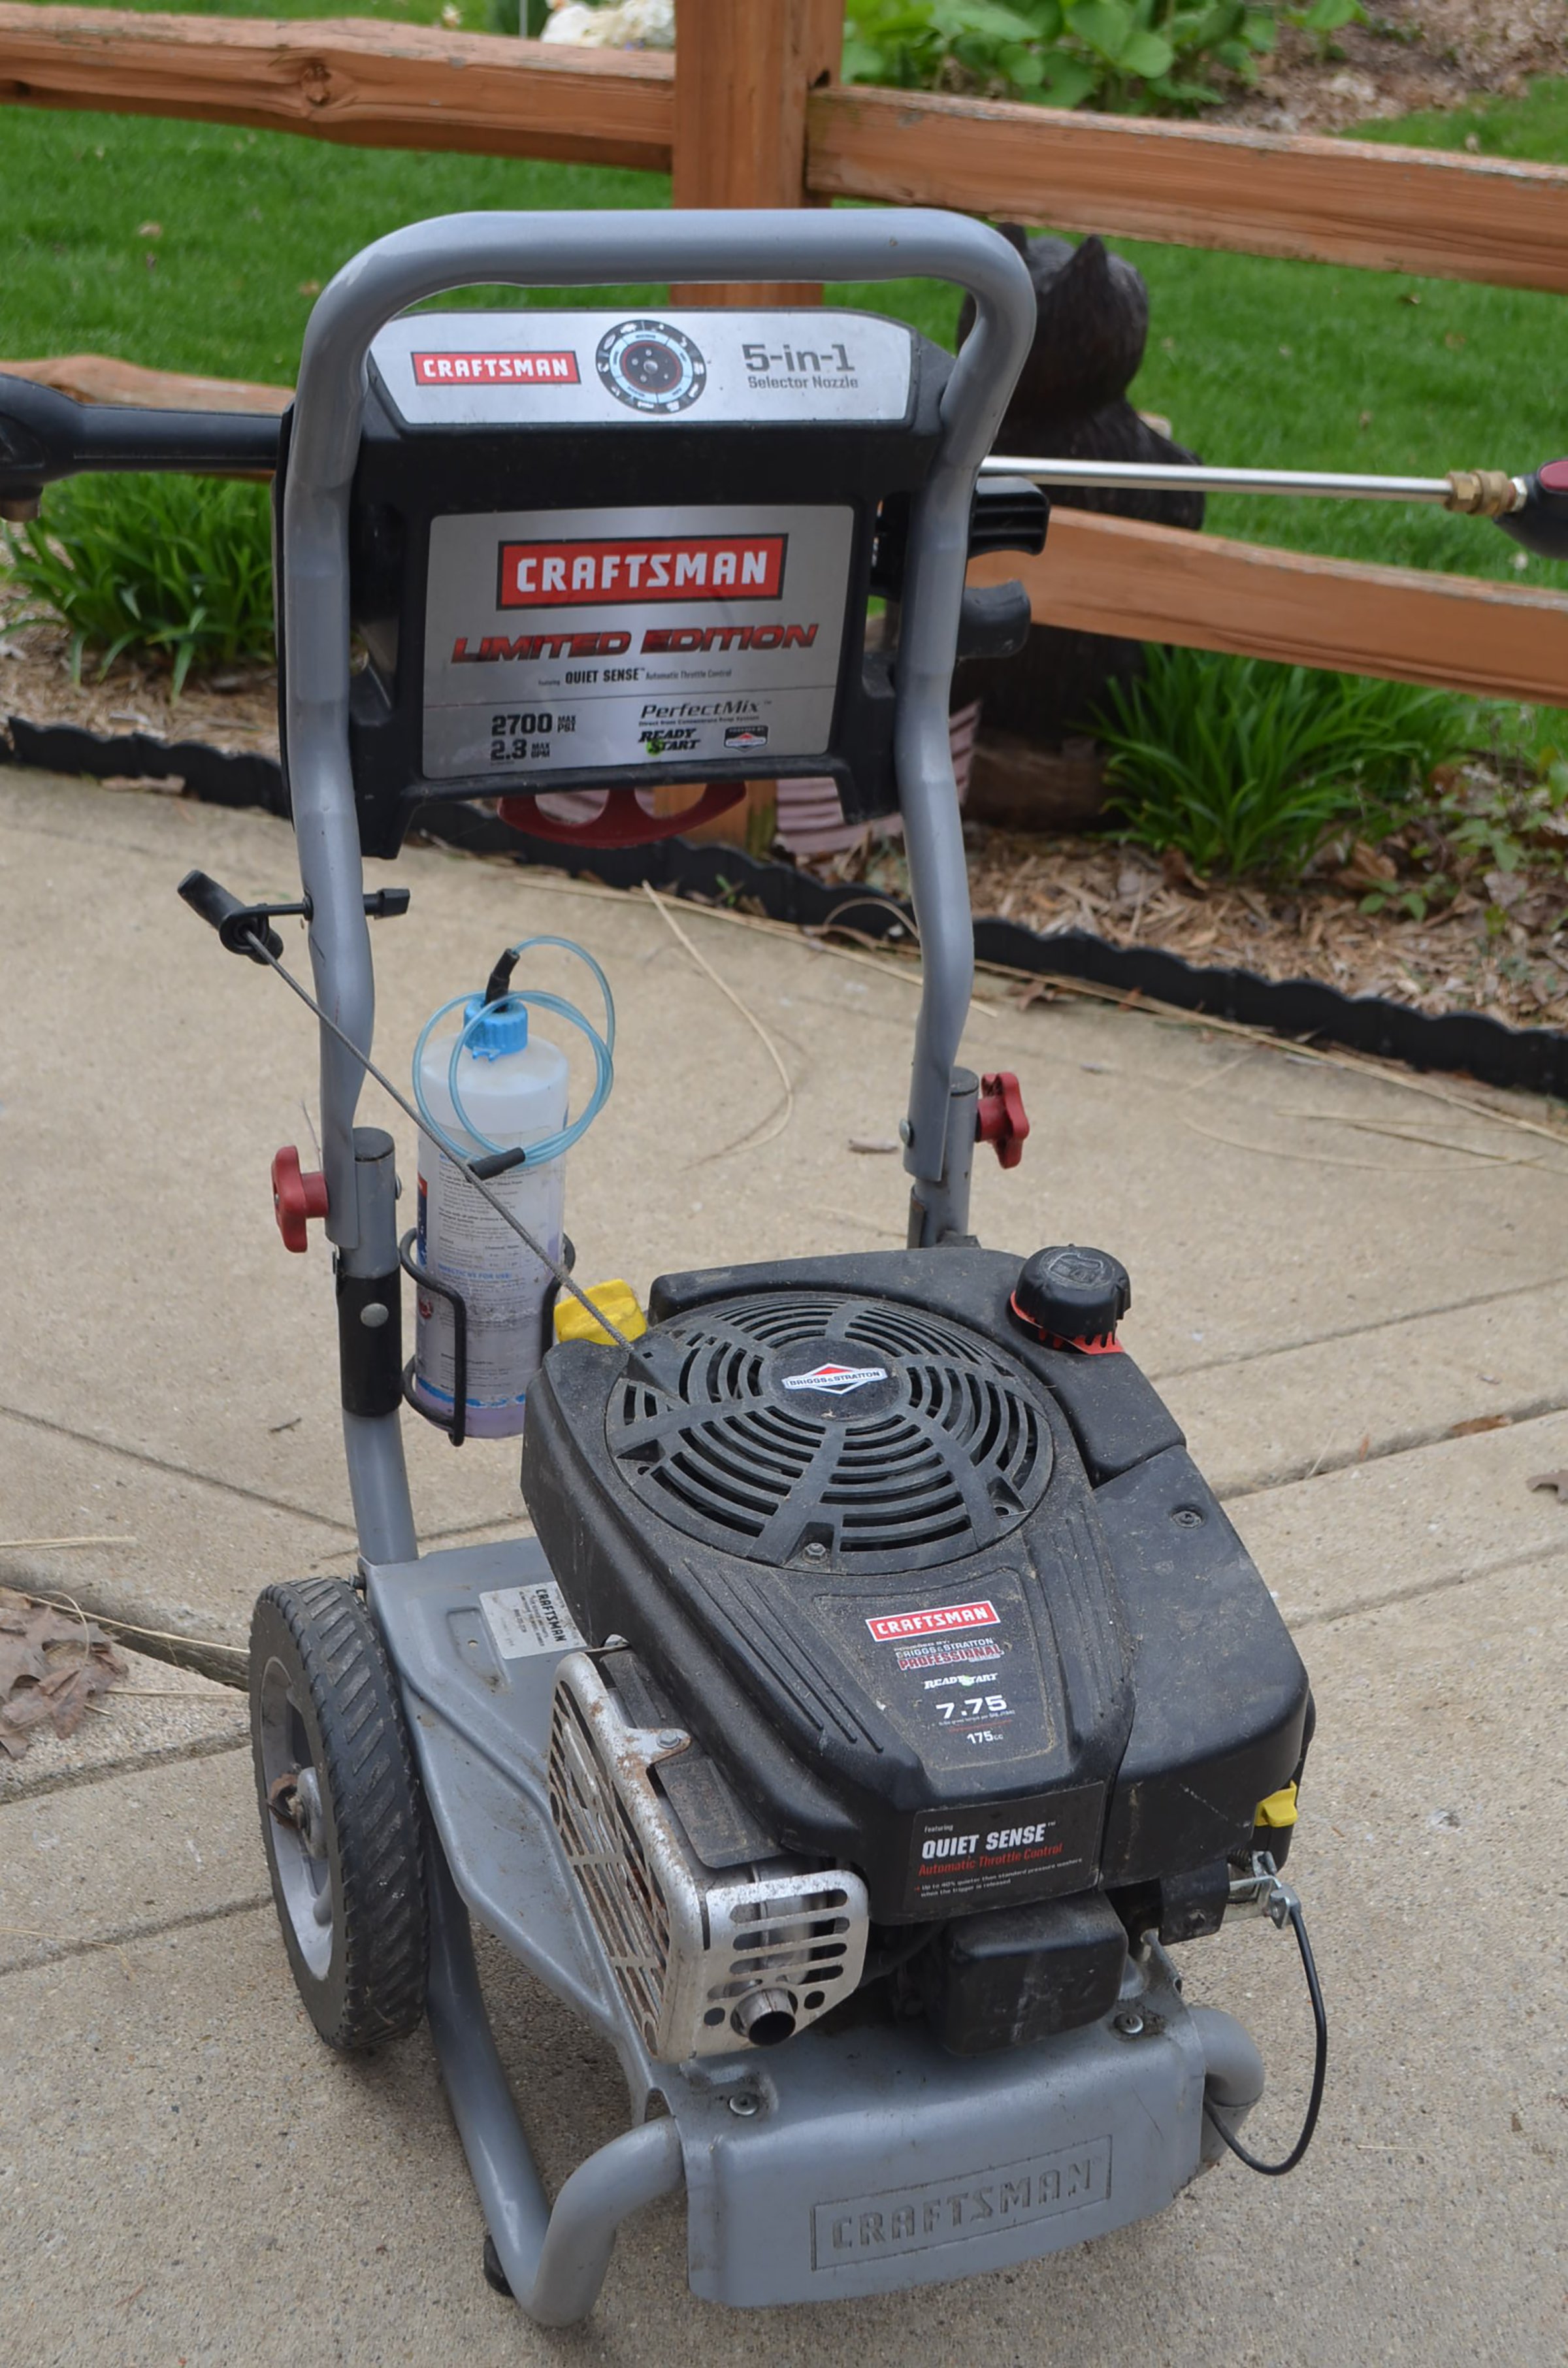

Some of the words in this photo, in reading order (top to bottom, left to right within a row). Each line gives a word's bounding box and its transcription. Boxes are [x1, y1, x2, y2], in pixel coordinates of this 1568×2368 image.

[423, 359, 568, 378] CRAFTSMAN
[742, 344, 855, 372] 5-in-1
[747, 376, 809, 389] Selector
[812, 374, 858, 388] Nozzle
[516, 551, 768, 593] CRAFTSMAN
[450, 631, 632, 664] LIMITED
[640, 623, 820, 655] EDITION
[565, 670, 599, 685] QUIET
[491, 713, 553, 736] 2700
[557, 715, 576, 723] MAX
[638, 728, 696, 743] READY
[490, 738, 527, 761] 2.3
[531, 742, 551, 750] MAX
[536, 1588, 567, 1642] CRAFTSMAN
[876, 1606, 989, 1635] CRAFTSMAN
[897, 1643, 1004, 1671] PROFESSIONAL
[936, 1694, 1007, 1719] 7.75
[921, 1834, 980, 1860] QUIET
[918, 1858, 976, 1877] Automatic
[979, 1851, 1022, 1868] Throttle
[1023, 1843, 1064, 1861] Control
[998, 1869, 1028, 1880] standard
[1028, 1864, 1056, 1875] pressure
[983, 1878, 1011, 1888] released
[832, 2158, 1092, 2249] CRAFTSMAN
